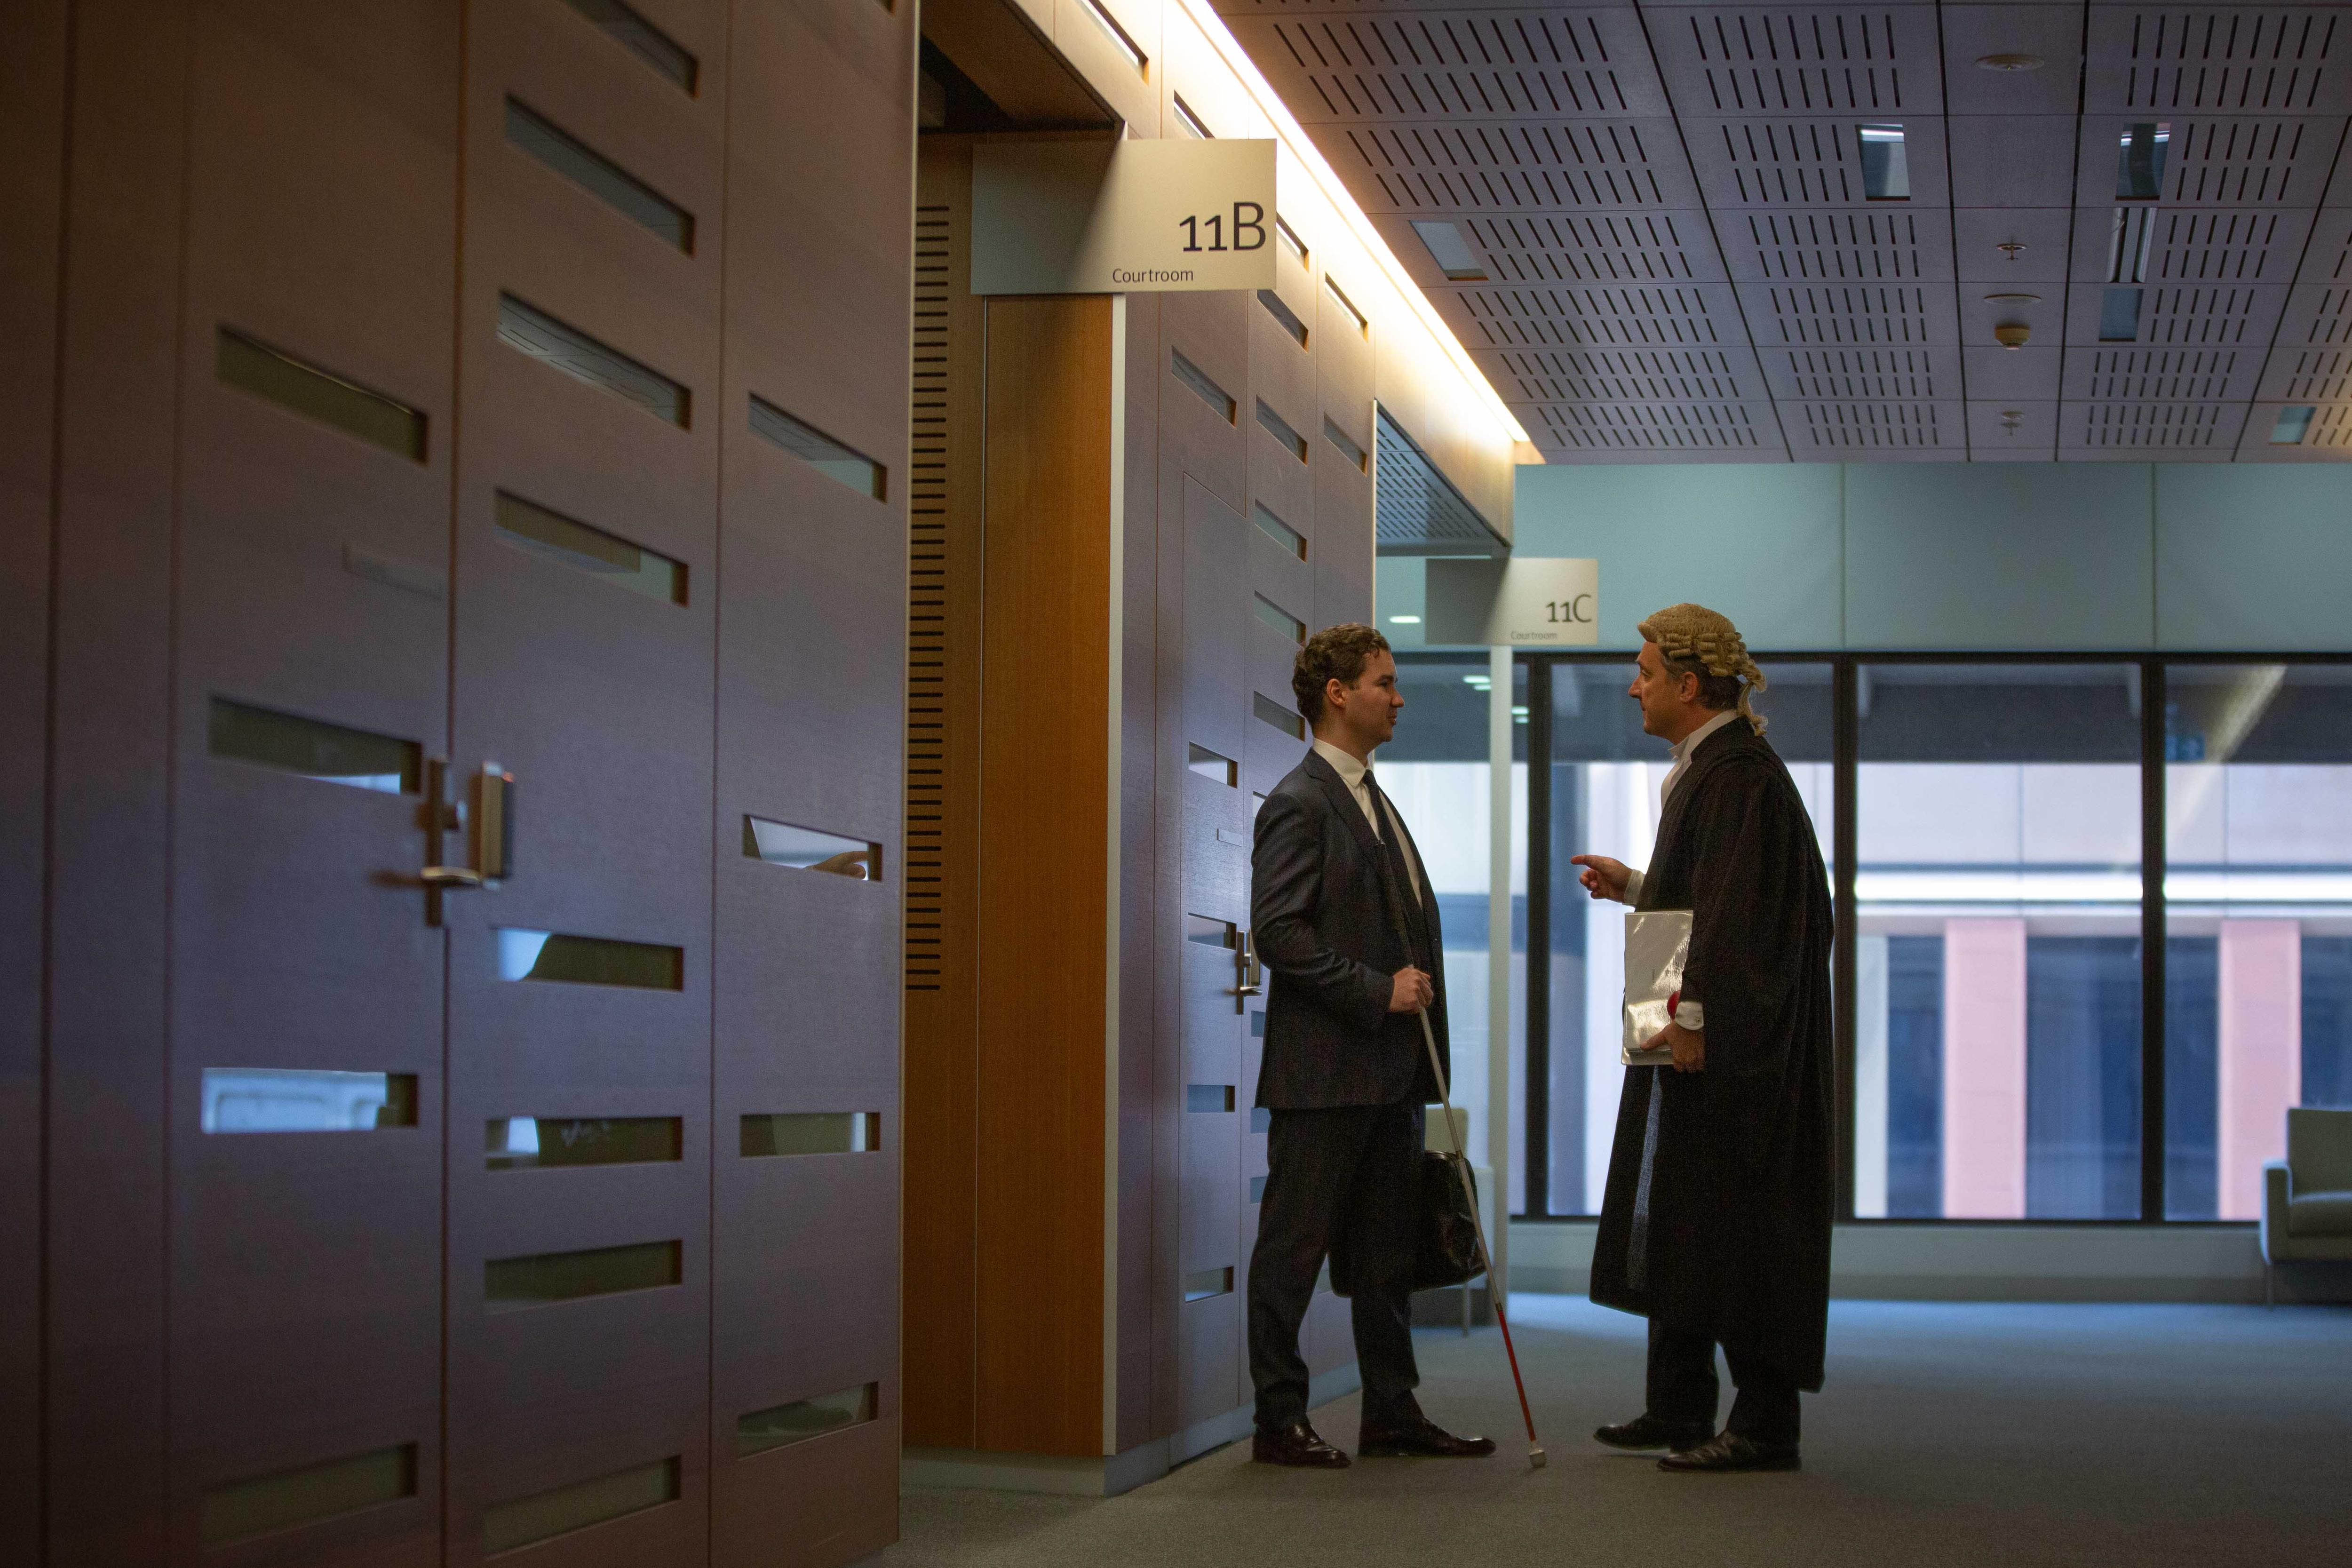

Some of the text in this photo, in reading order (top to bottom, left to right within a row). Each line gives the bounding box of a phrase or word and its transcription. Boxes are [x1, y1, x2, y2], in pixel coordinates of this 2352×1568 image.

[1179, 201, 1266, 252] 11B
[1112, 268, 1193, 283] Courtroom
[1545, 594, 1592, 623] 11C
[1510, 631, 1557, 640] Courtroom
